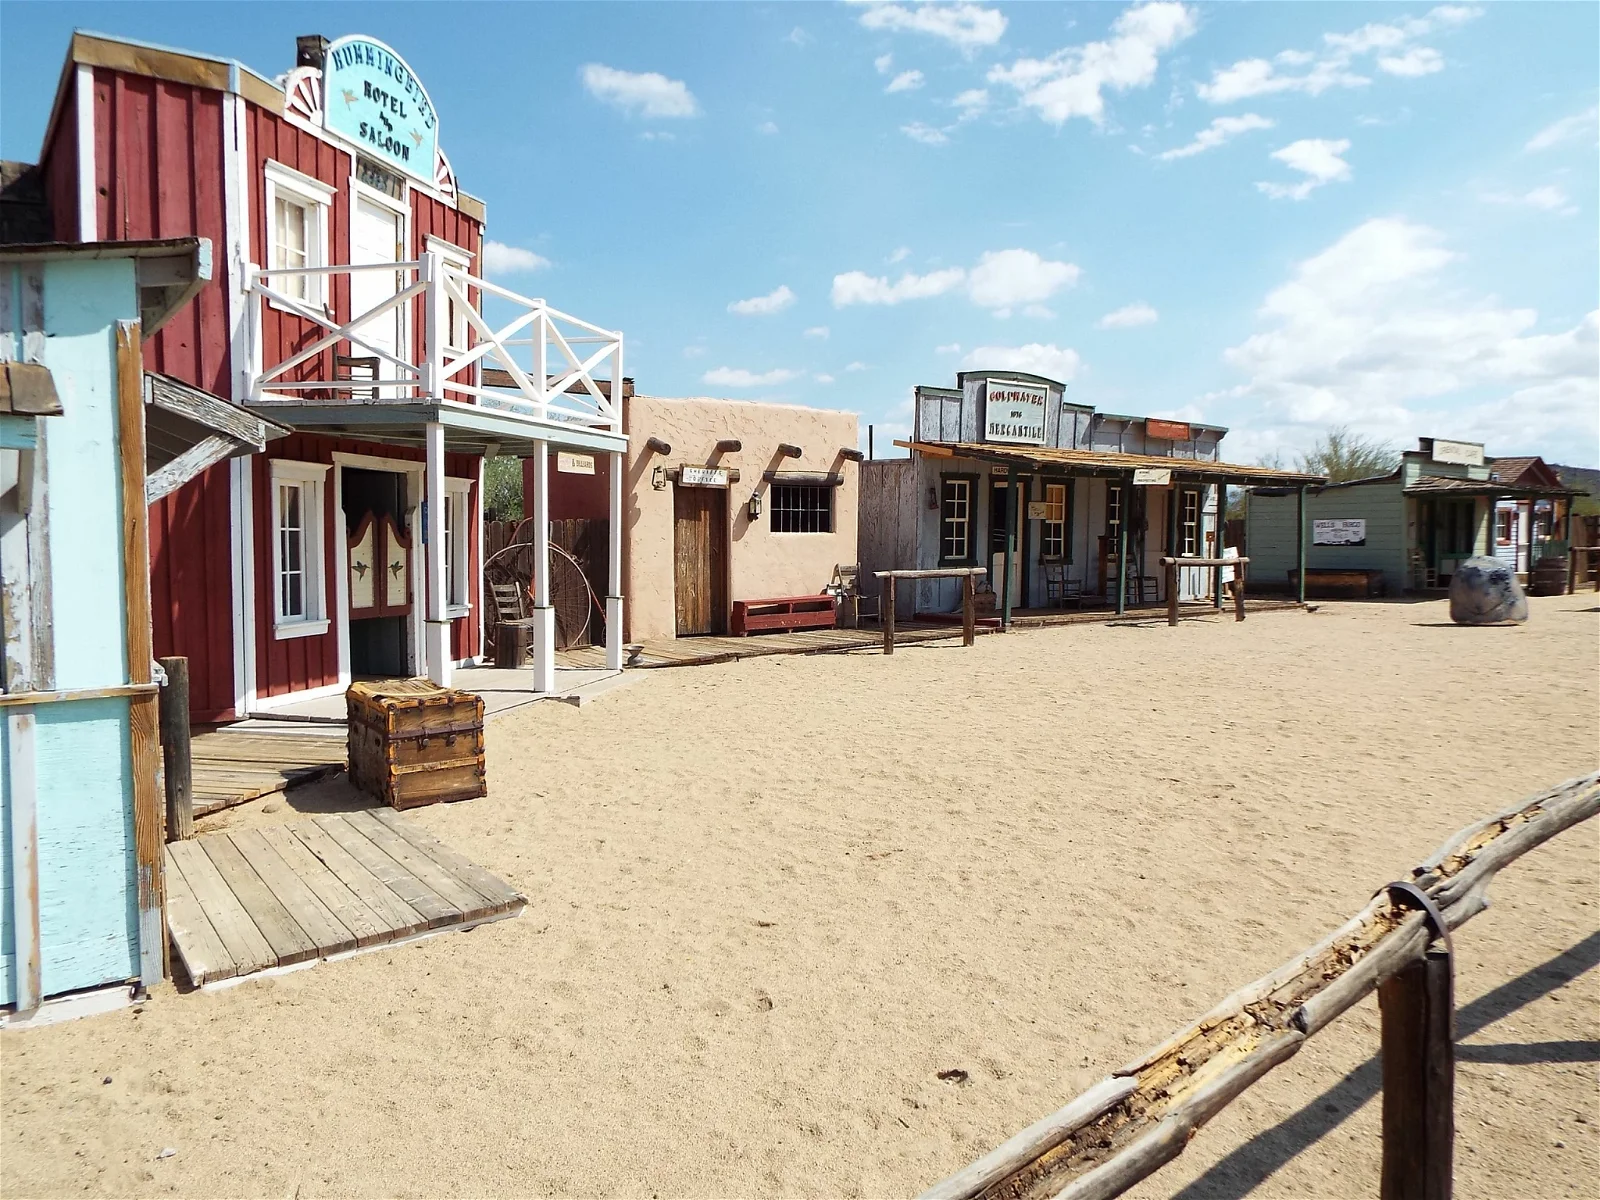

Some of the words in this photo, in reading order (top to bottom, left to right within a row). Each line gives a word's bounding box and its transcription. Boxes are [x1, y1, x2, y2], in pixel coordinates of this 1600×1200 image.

[331, 43, 437, 130] HUMMINGBIRD
[363, 80, 407, 119] HOTEL
[359, 121, 410, 162] SALOON
[989, 422, 1041, 438] MERCANTILE
